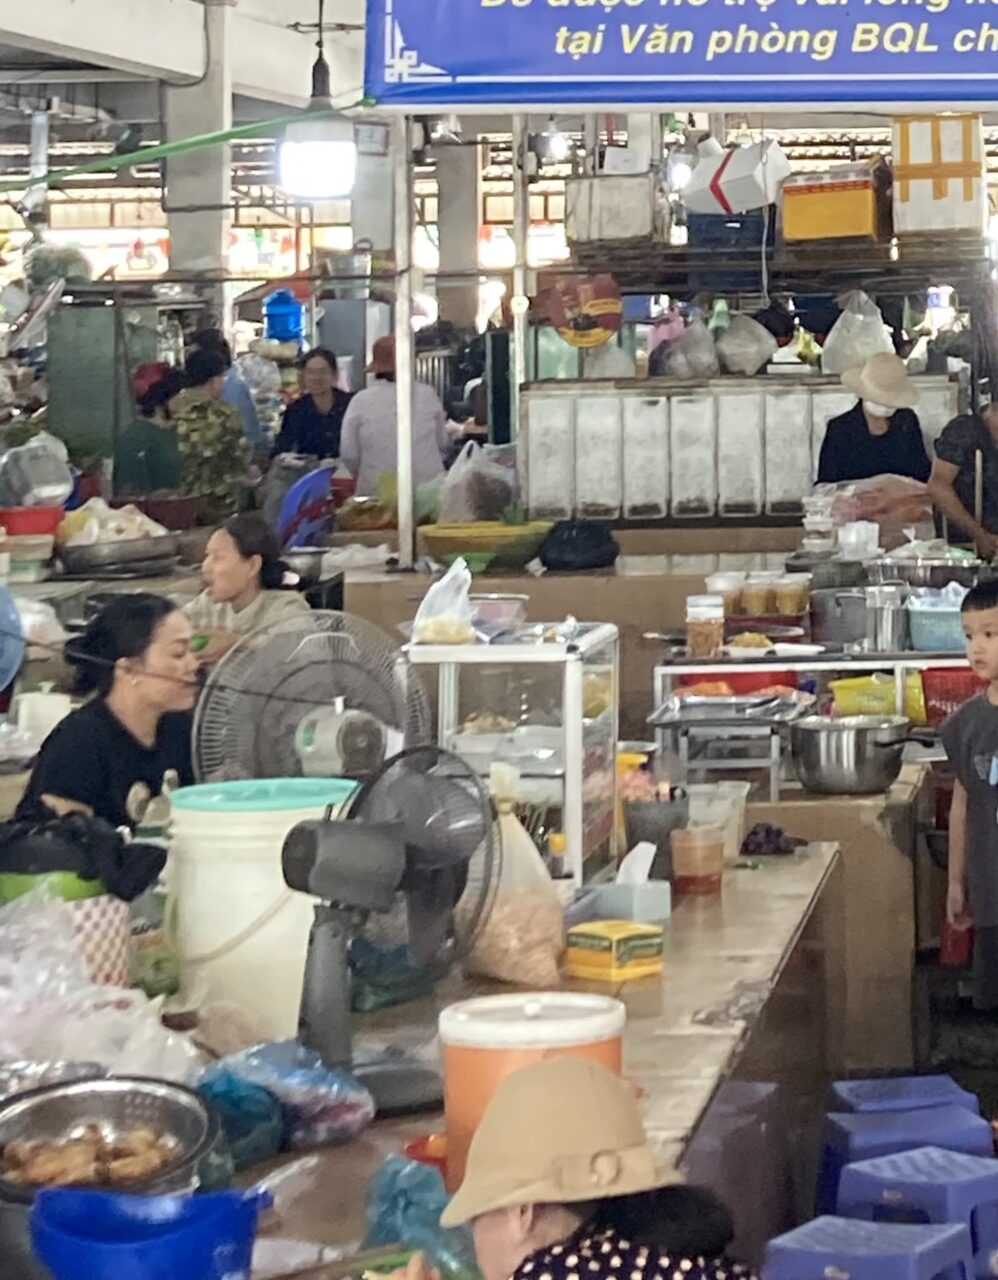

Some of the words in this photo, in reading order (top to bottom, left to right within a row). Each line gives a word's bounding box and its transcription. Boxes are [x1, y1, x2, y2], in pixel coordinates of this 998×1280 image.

[555, 24, 605, 60] tại
[621, 24, 693, 53] Văn
[706, 23, 837, 60] phòng
[852, 22, 938, 52] BQL
